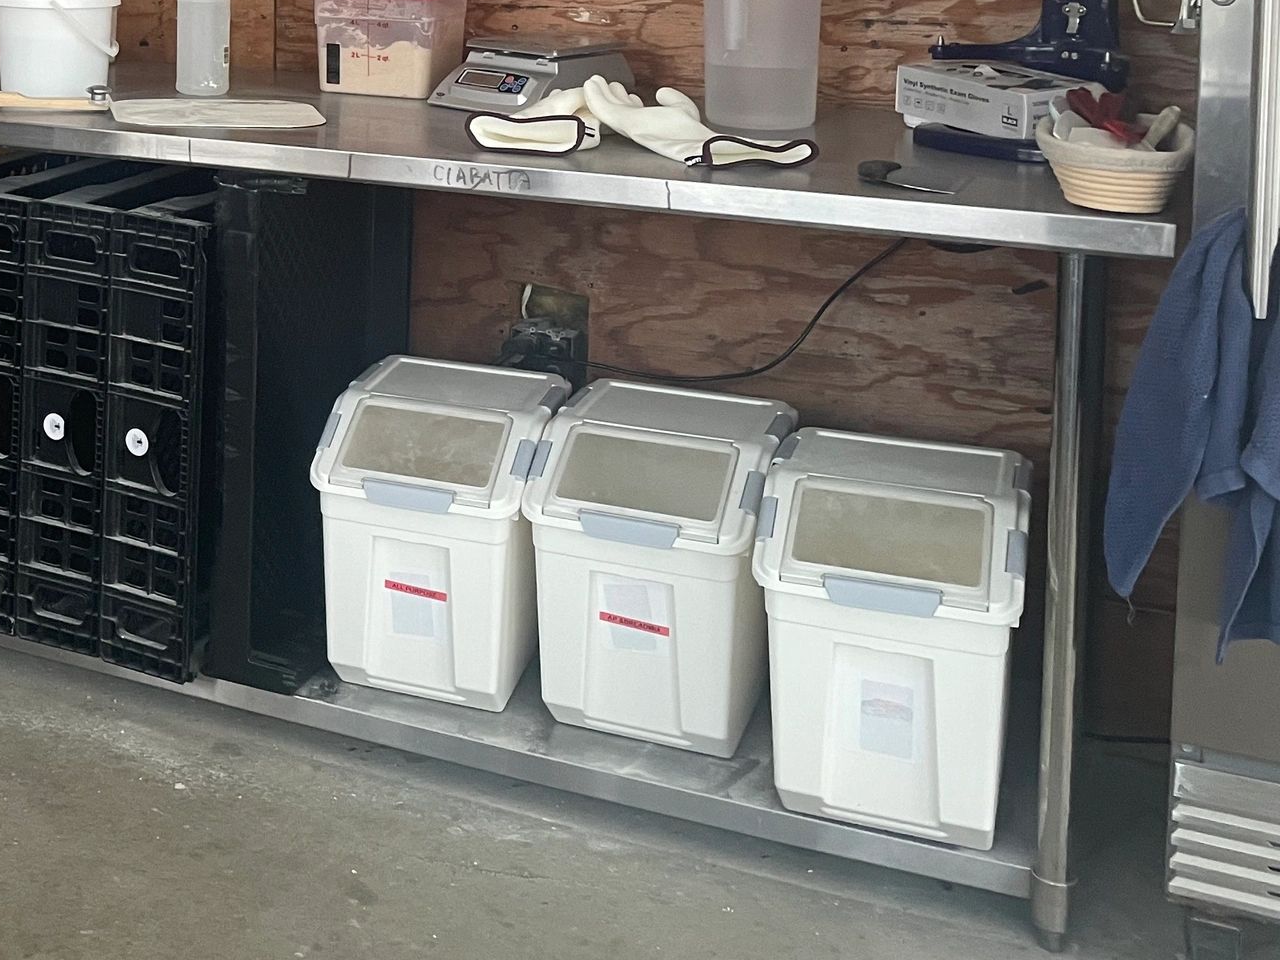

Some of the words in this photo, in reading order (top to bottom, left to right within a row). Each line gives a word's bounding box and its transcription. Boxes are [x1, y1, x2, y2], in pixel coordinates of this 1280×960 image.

[903, 78, 919, 88] Vinyl
[919, 81, 948, 94] Synthetic
[949, 88, 967, 98] Exam
[967, 93, 990, 103] Gloves
[1002, 117, 1017, 126] BLACK
[433, 164, 531, 191] CIABATTA
